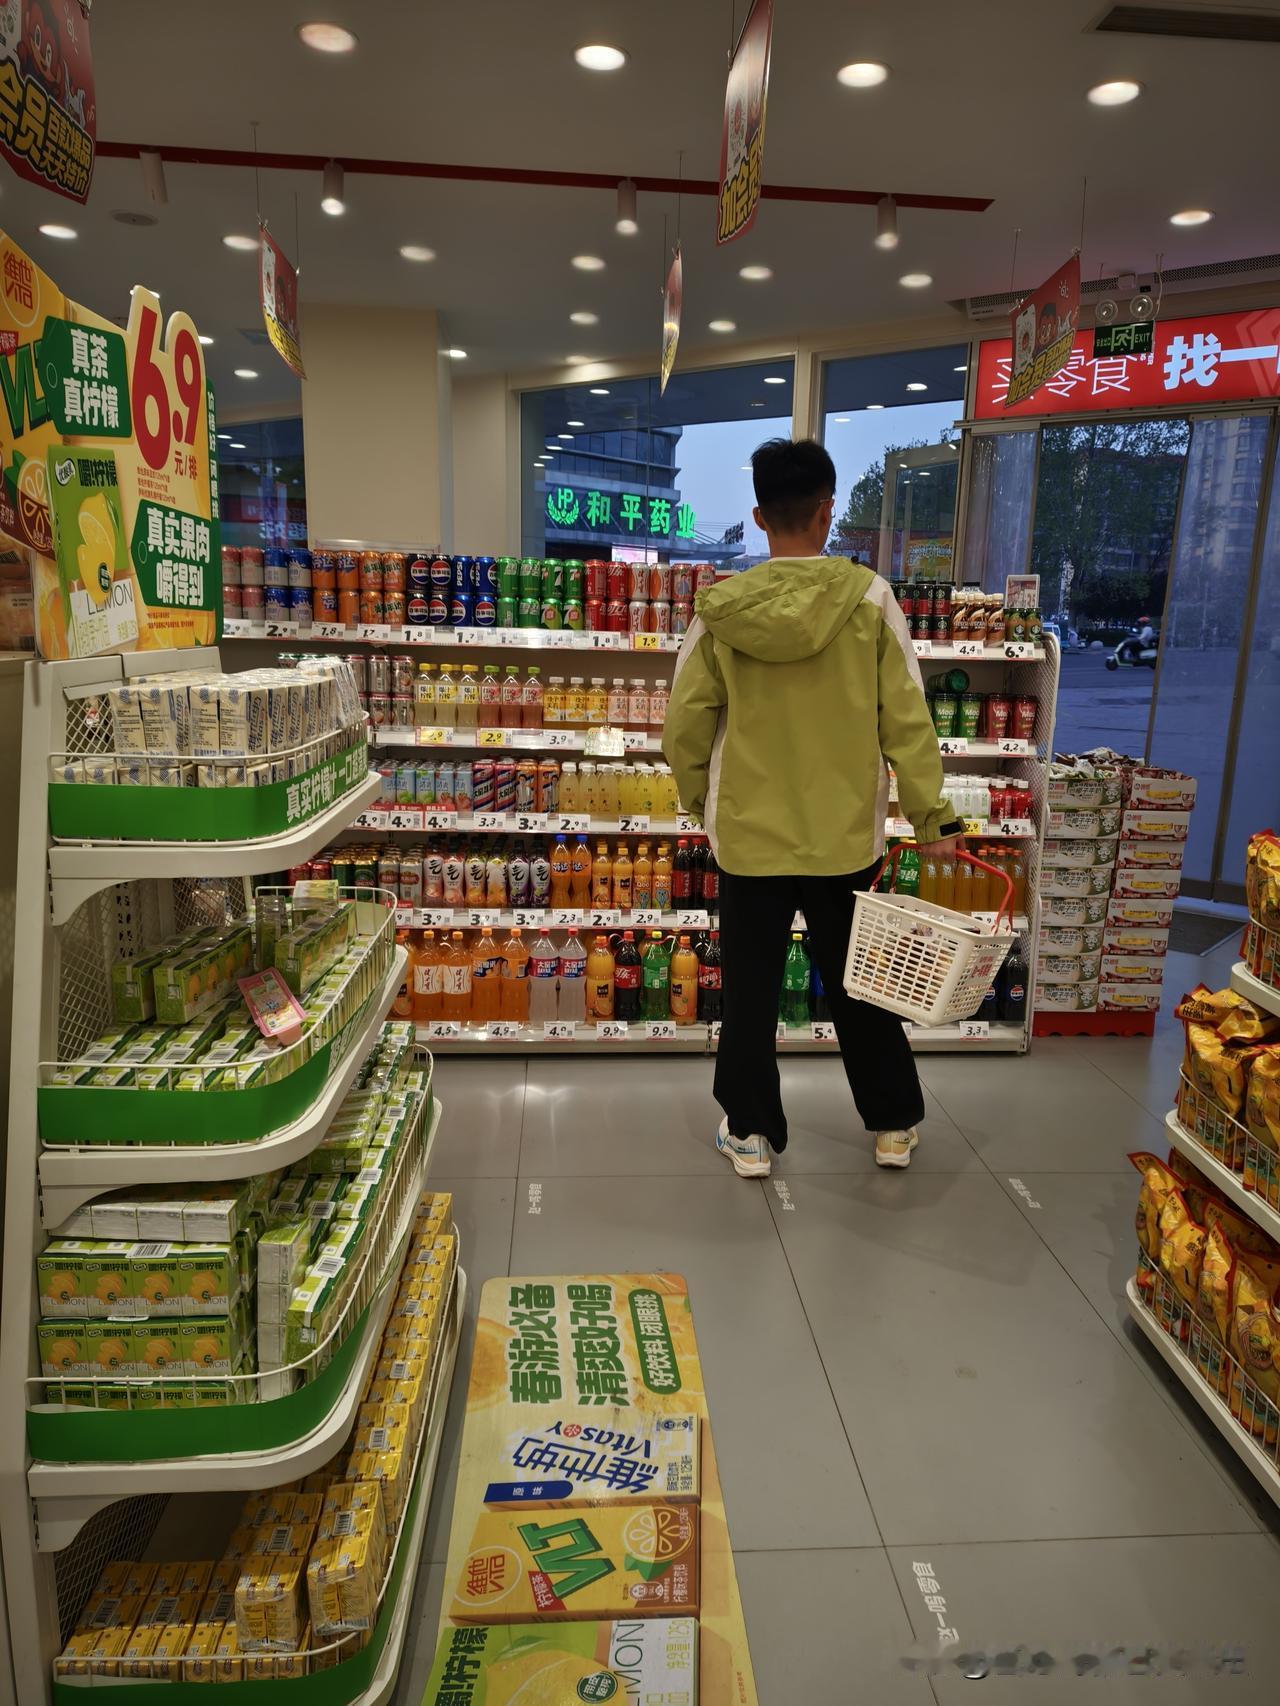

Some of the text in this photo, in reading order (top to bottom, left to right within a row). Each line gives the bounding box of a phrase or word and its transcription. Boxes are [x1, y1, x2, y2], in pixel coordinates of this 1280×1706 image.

[1135, 332, 1151, 344] EXIT
[70, 328, 109, 380] 真茶
[132, 304, 202, 471] 6.9
[63, 377, 119, 429] 真柠檬
[586, 488, 696, 539] 和平药业
[146, 506, 211, 564] 真实果肉
[266, 624, 288, 637] 2.9
[959, 645, 976, 655] 4.4
[1005, 646, 1025, 658] 6.9
[485, 733, 502, 743] 2.9
[549, 735, 567, 744] 3.9
[940, 742, 958, 753] 4.2
[1002, 743, 1019, 752] 4.2
[356, 814, 378, 826] 4.9
[391, 816, 411, 828] 4.9
[428, 816, 448, 828] 4.9
[478, 817, 496, 827] 3.3
[518, 818, 538, 831] 3.3
[560, 819, 580, 831] 2.9
[620, 820, 639, 831] 2.9
[1001, 823, 1019, 835] 4.5
[422, 914, 442, 925] 3.9
[515, 914, 535, 925] 3.9
[559, 914, 576, 923] 2.3
[592, 915, 611, 926] 2.9
[636, 914, 653, 923] 2.9
[682, 915, 699, 924] 2.2
[434, 1026, 451, 1036] 4.5
[492, 1026, 510, 1036] 4.9
[603, 1026, 620, 1036] 9.9
[652, 1026, 669, 1036] 9.9
[813, 1027, 833, 1039] 5.4
[966, 1026, 982, 1036] 3.3
[508, 1283, 563, 1405] 春游必备
[566, 1284, 631, 1407] 清爽好喝
[633, 1293, 677, 1388] 好饮料 闭眼挑
[512, 1436, 659, 1494] 維他奶
[517, 1518, 617, 1600] VLT
[532, 1572, 554, 1609] 柠檬茶
